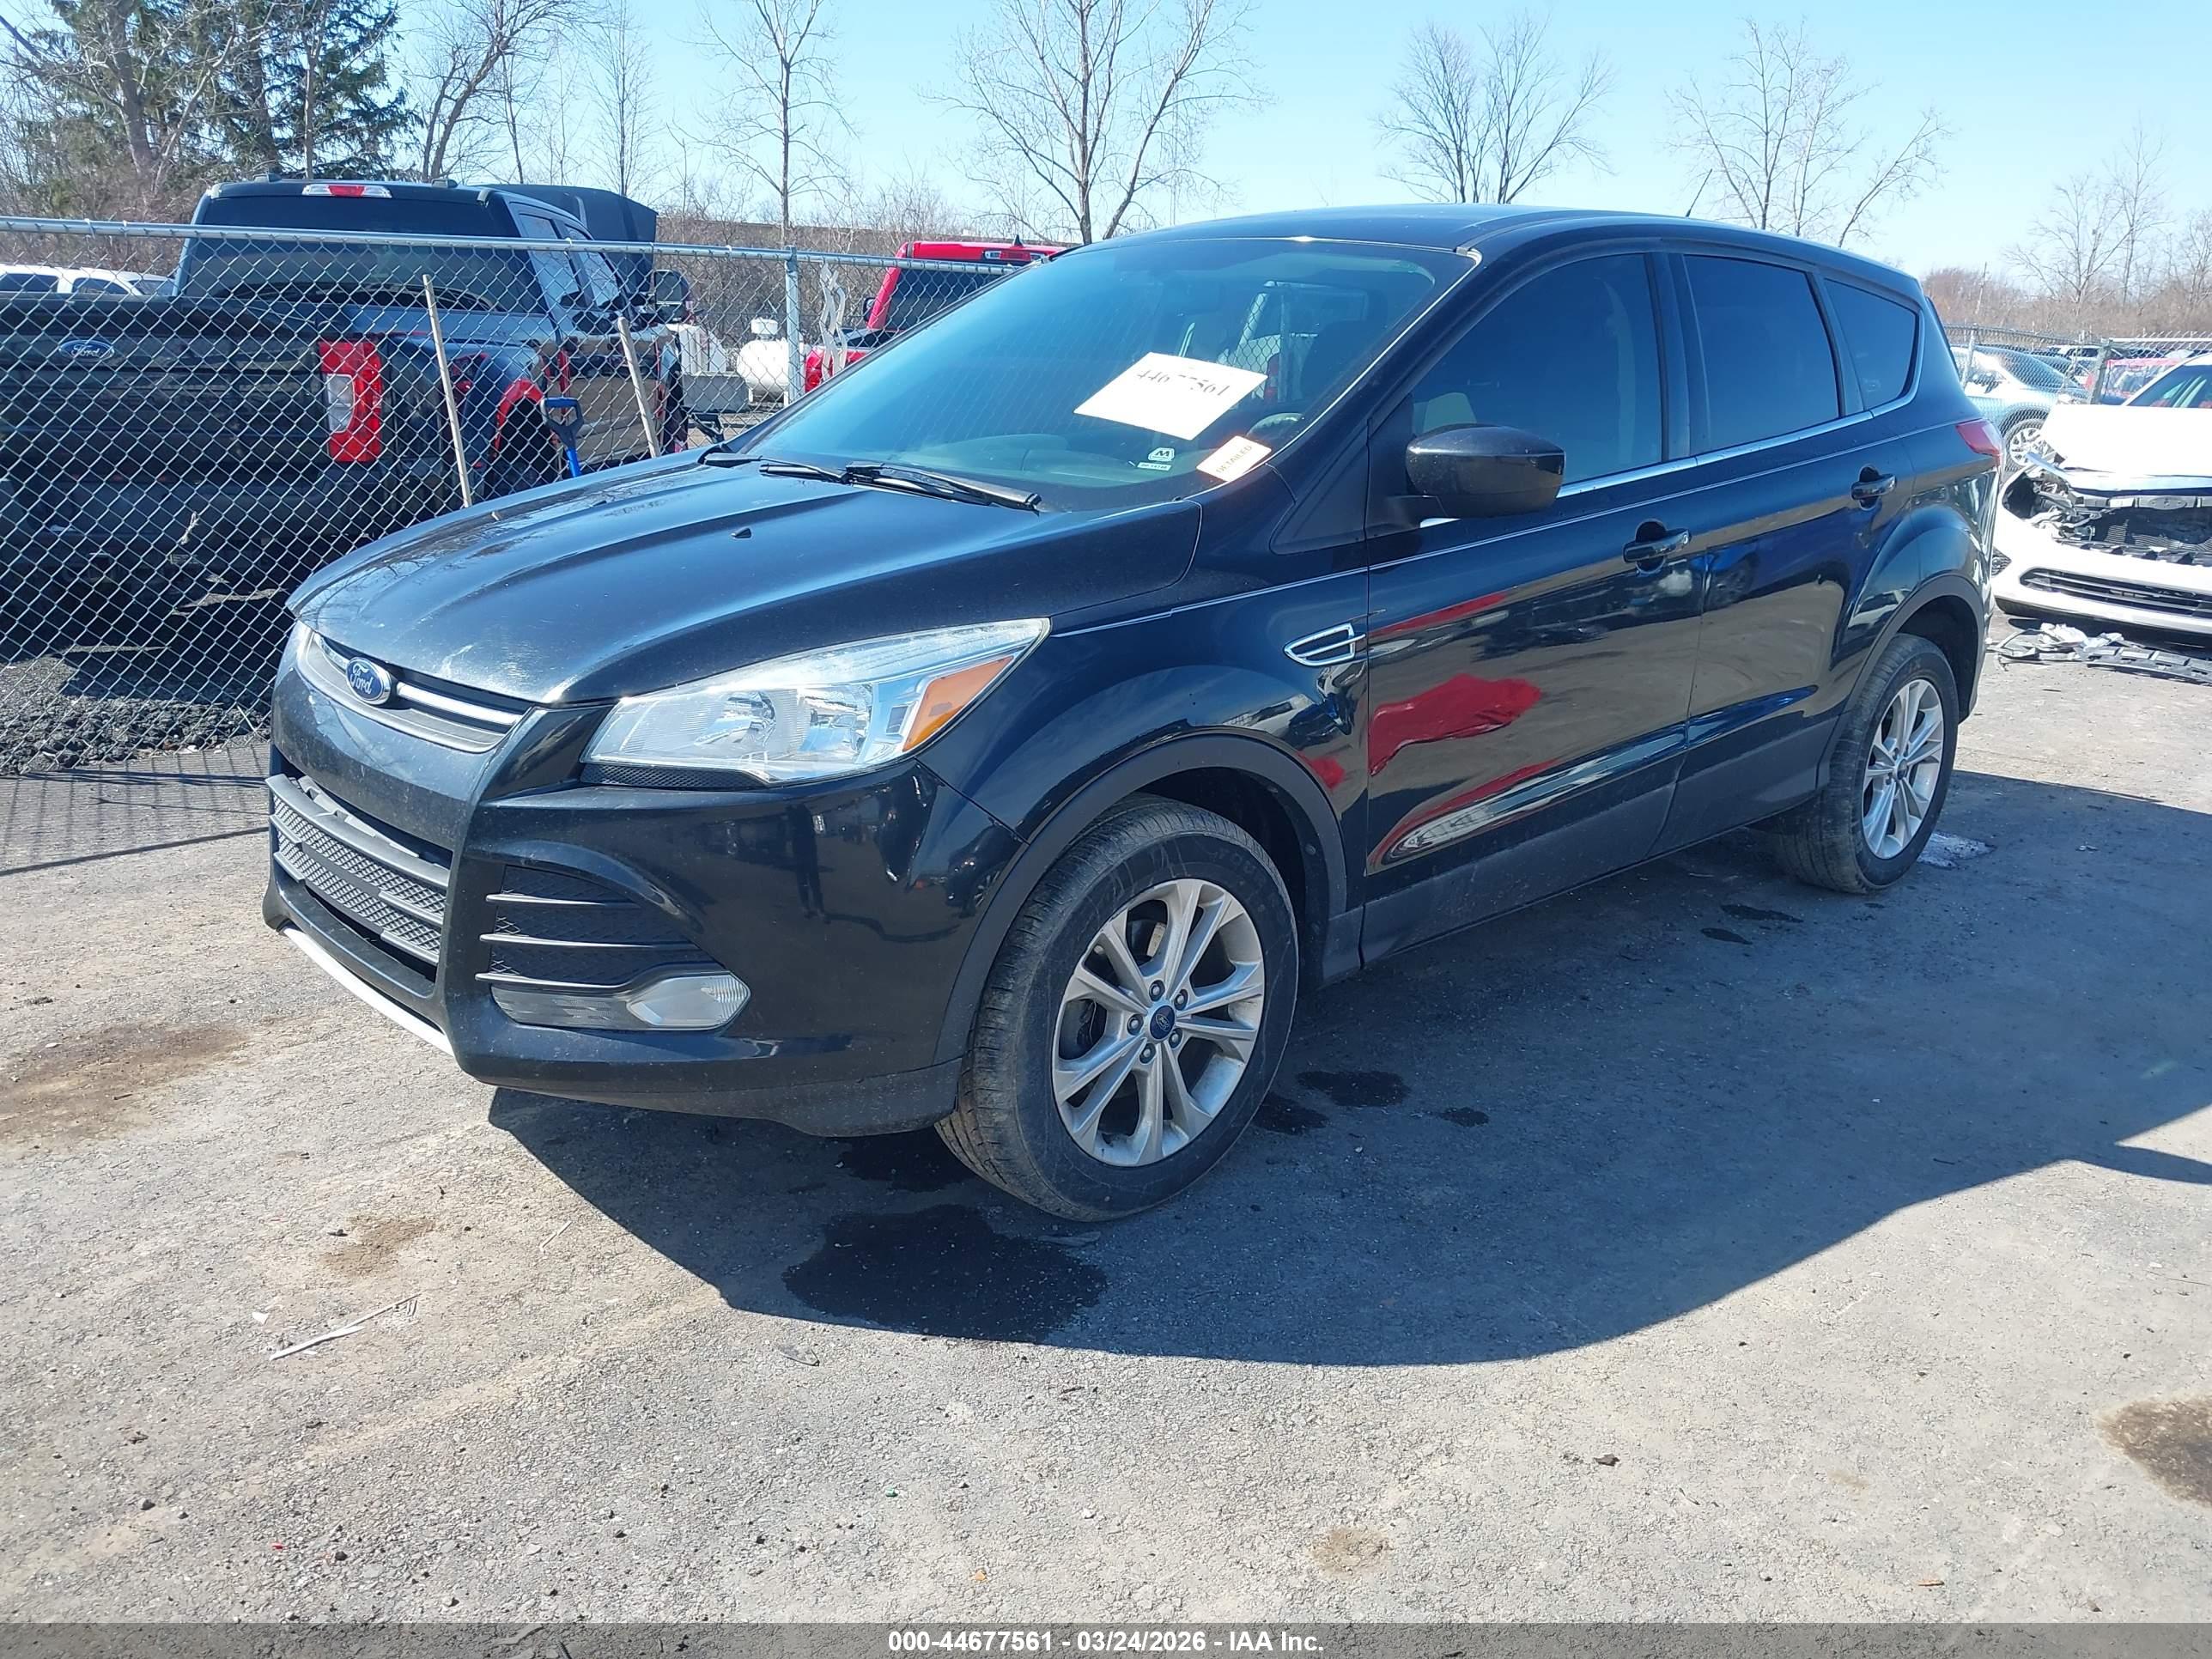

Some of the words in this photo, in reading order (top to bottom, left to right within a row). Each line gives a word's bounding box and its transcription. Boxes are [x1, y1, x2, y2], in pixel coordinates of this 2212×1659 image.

[71, 343, 100, 357] Ford
[1215, 445, 1253, 473] DETAILED
[349, 662, 374, 695] Ford
